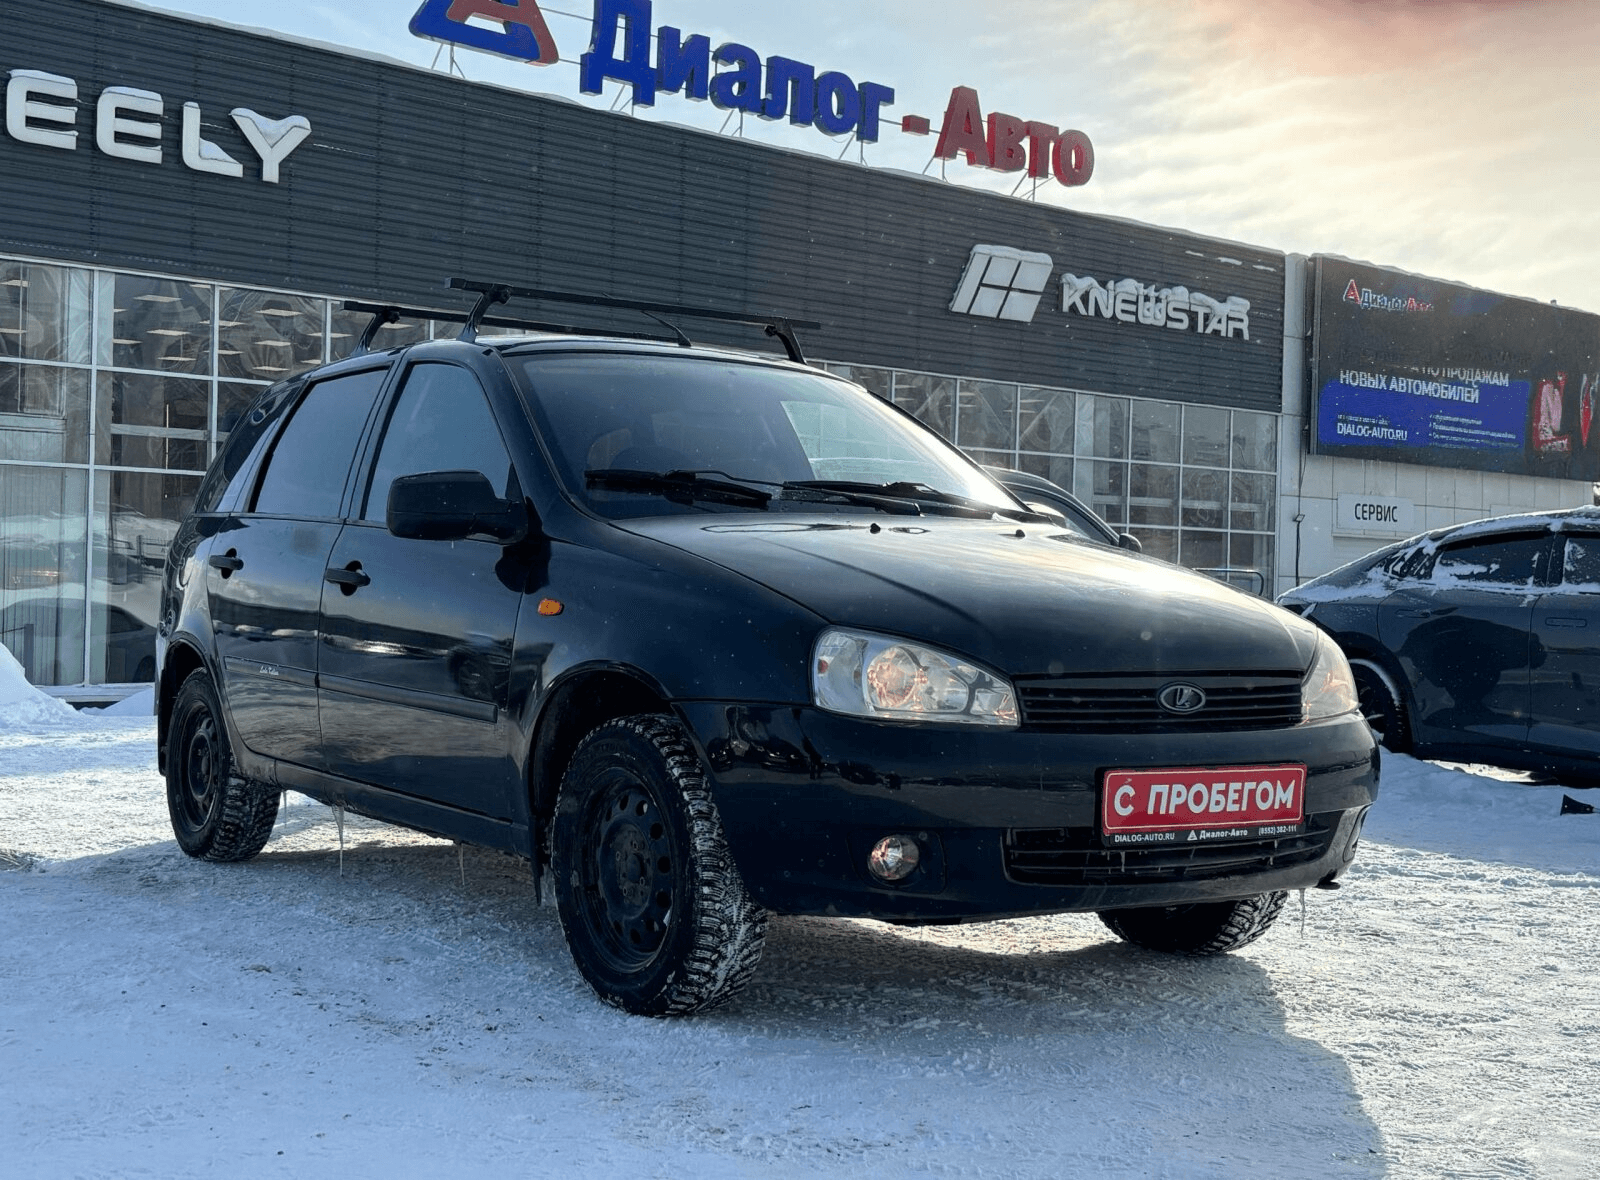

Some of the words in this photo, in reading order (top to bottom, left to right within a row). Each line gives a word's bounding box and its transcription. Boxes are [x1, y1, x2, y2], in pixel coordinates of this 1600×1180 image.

[6, 69, 312, 184] EELY
[1061, 274, 1250, 340] KNEWSTAR
[1339, 369, 1388, 391] НОВЫХ
[1389, 376, 1480, 404] АВТОМОБИЛЕЙ
[1442, 367, 1509, 387] ПРОДАЖАМ
[1337, 422, 1408, 441] DIALOG-AUTO.RU
[1354, 503, 1398, 522] СЕРВИС
[1113, 784, 1136, 816] С
[1147, 780, 1296, 815] ПРОБЕГОМ
[1114, 832, 1175, 843] DIALOG-AUTO.RU
[1199, 828, 1248, 840] Диалог-Авто
